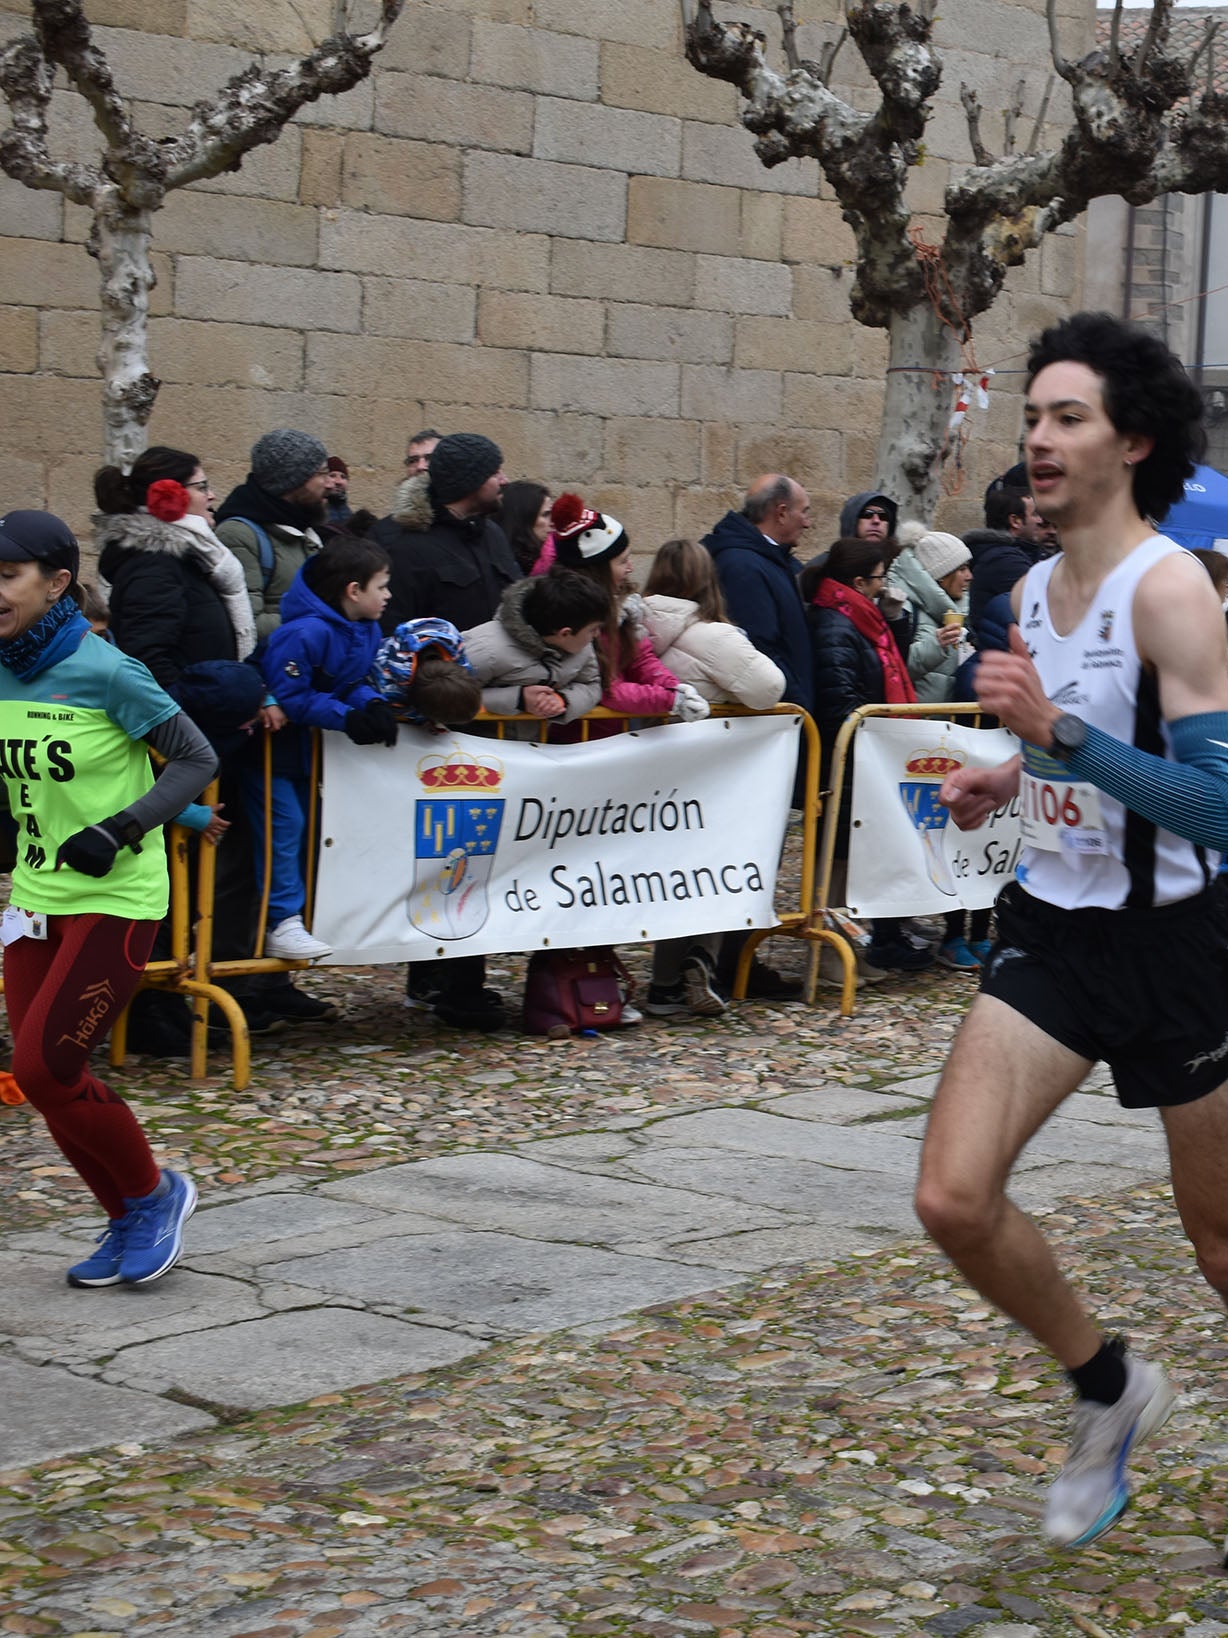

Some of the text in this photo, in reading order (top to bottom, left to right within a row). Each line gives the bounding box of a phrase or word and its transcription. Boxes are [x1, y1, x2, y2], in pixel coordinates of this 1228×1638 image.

[27, 710, 51, 720] RUNNING
[58, 713, 75, 721] BIKE
[514, 788, 704, 849] Diputación
[977, 837, 1022, 876] Sal
[505, 862, 764, 912] de Salamanca
